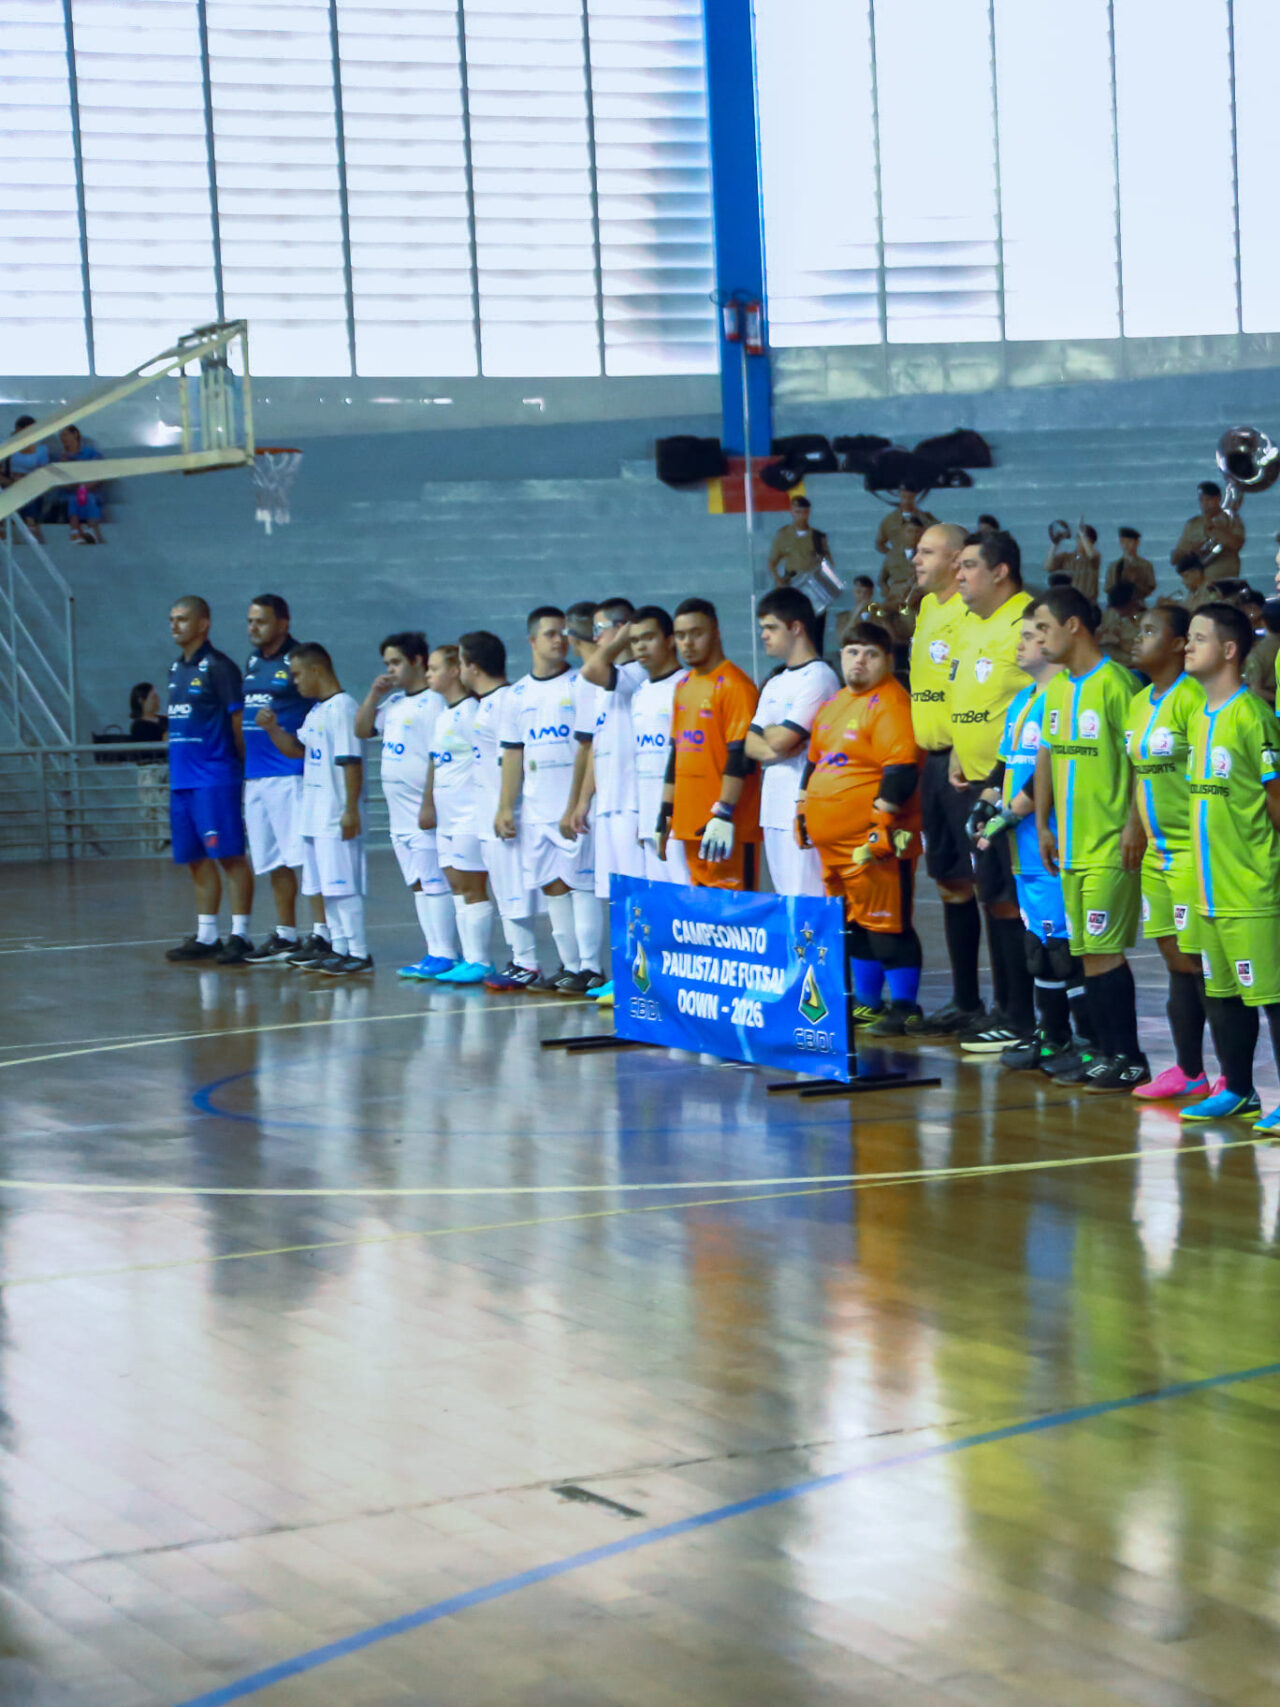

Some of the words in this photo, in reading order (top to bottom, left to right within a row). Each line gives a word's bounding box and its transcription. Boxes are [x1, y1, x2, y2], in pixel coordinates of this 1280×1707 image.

[672, 919, 767, 954] CAMPEONATO
[661, 951, 720, 983] PAULISTA
[720, 959, 738, 987] DE
[738, 962, 786, 995] FUTSAL
[677, 989, 719, 1020] DOWN
